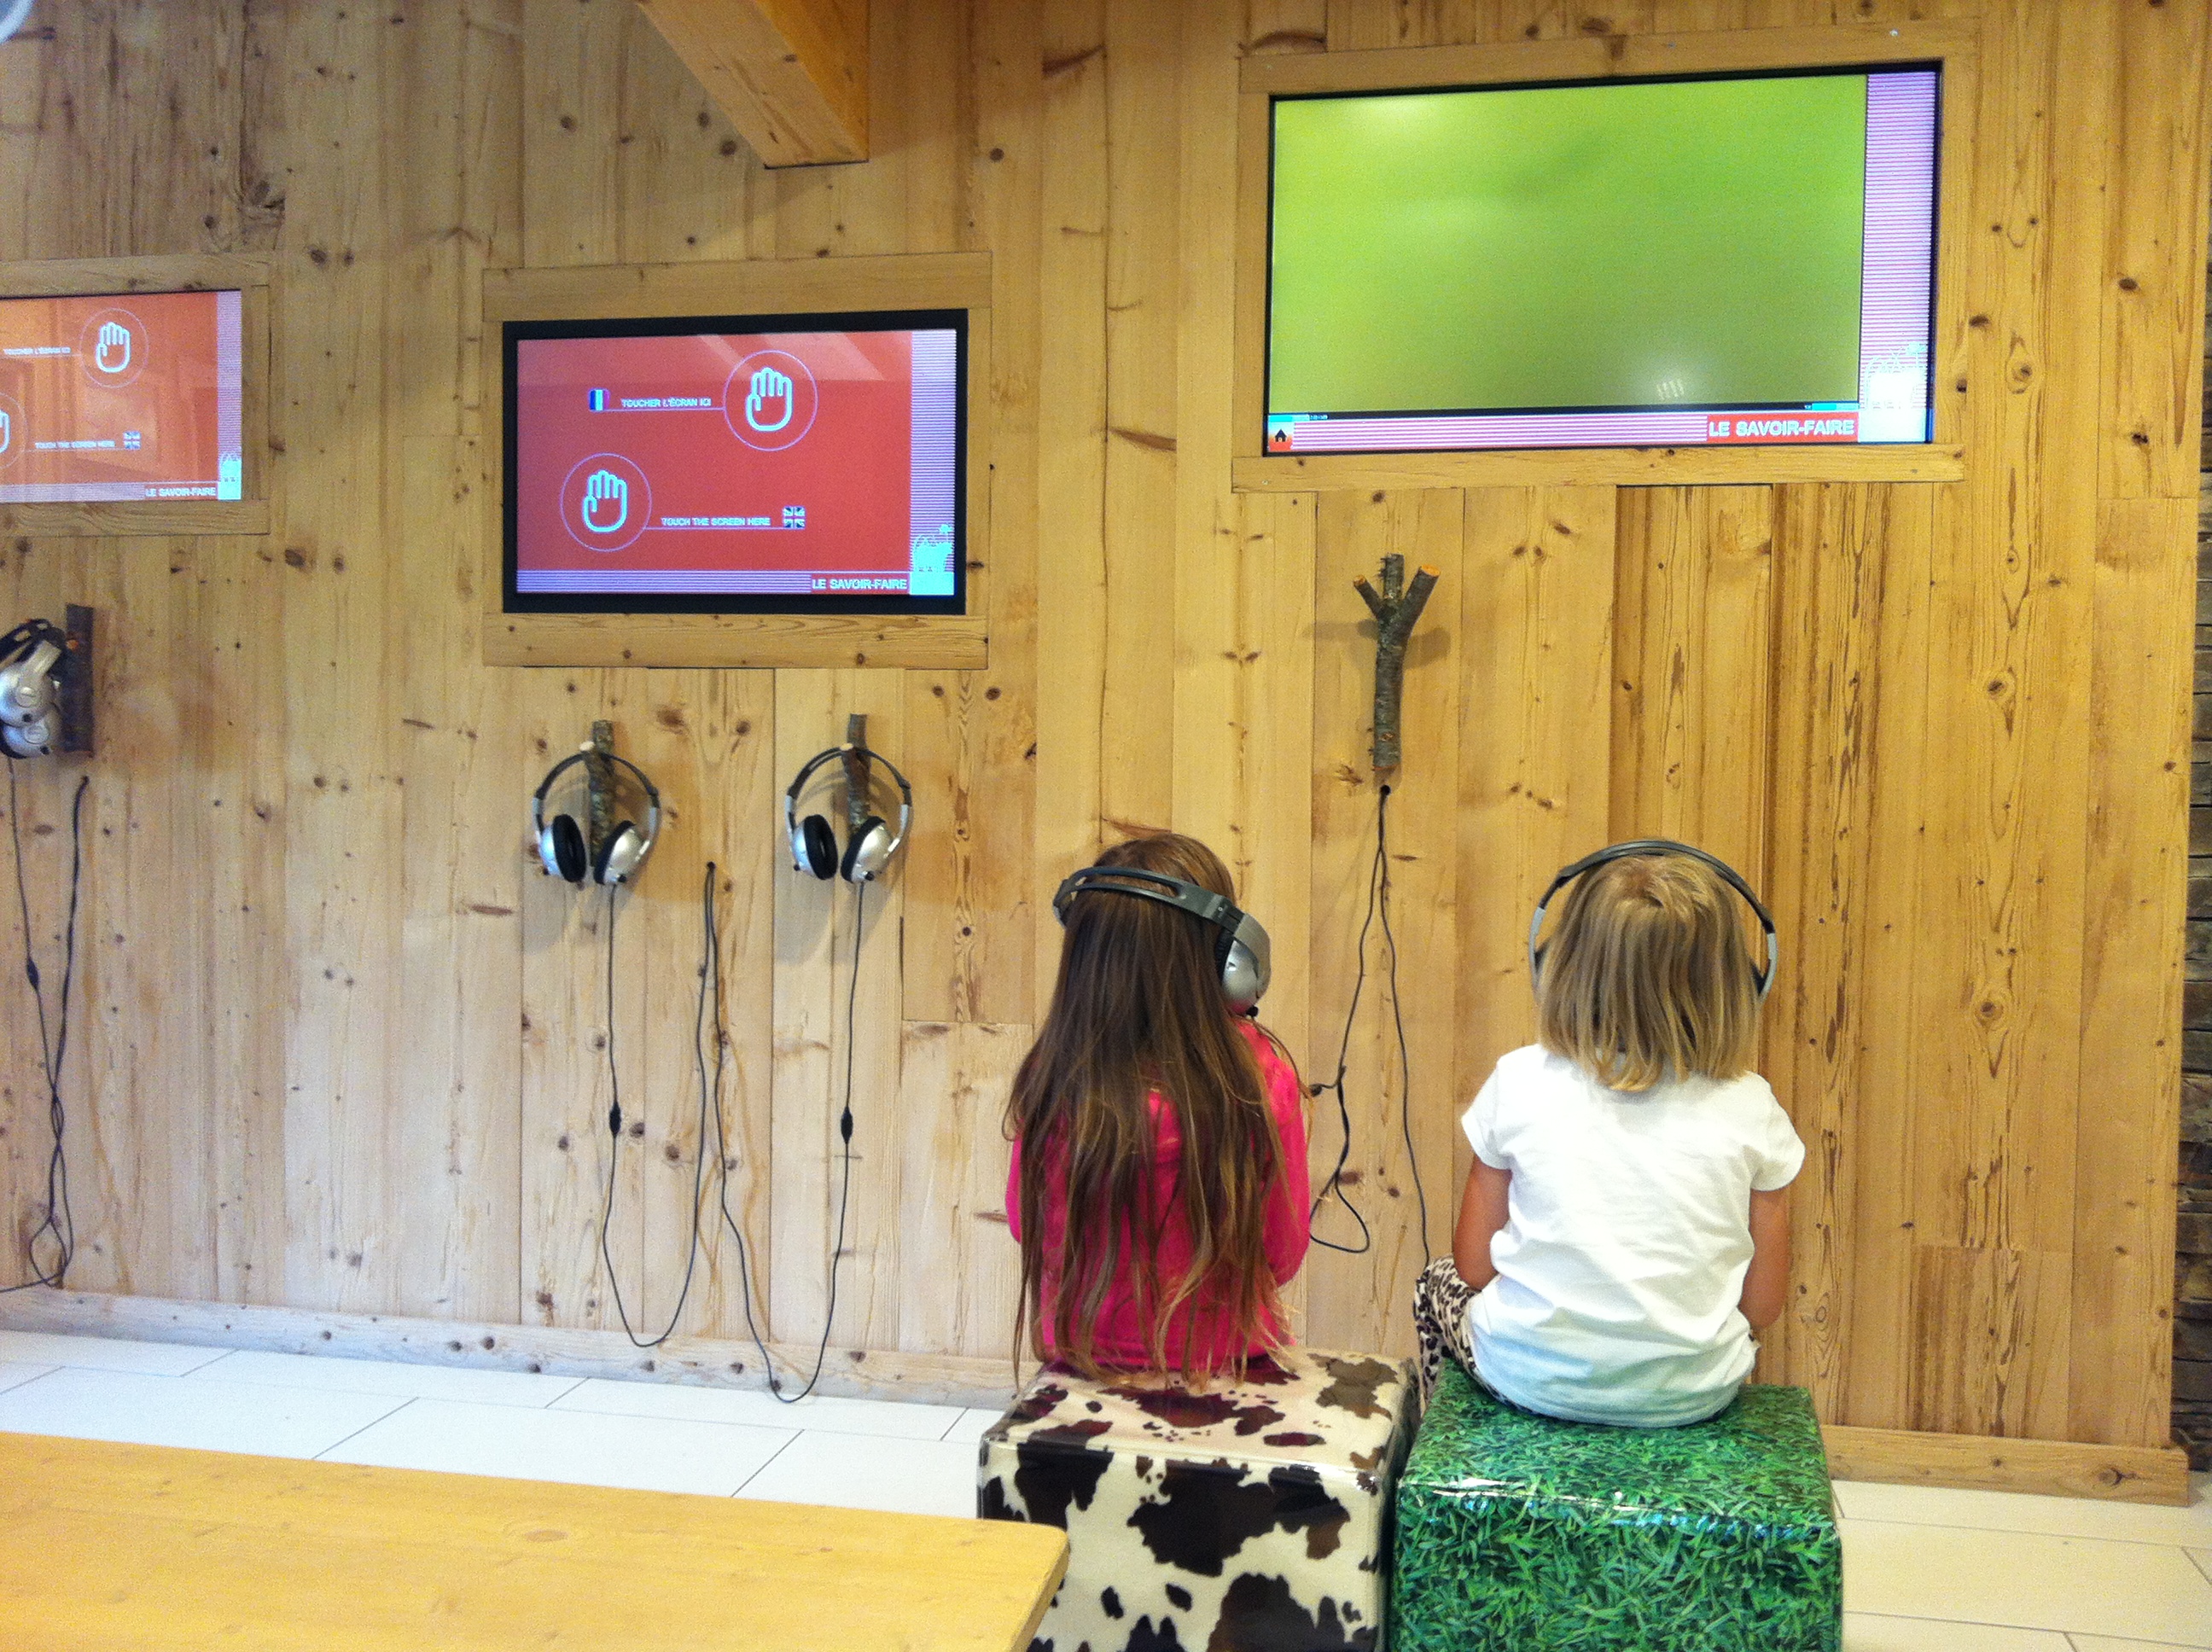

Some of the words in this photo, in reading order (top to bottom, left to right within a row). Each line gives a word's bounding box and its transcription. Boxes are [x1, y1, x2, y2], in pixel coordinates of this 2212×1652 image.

[620, 398, 661, 408] TOUCHER
[1708, 421, 1730, 437] LE
[1736, 419, 1855, 437] SAVOIR-FAIRE
[661, 517, 690, 526] TOUCH
[711, 517, 745, 526] SCREEN
[812, 579, 826, 590] LE
[830, 579, 907, 590] SAVOIR-FAIRE
